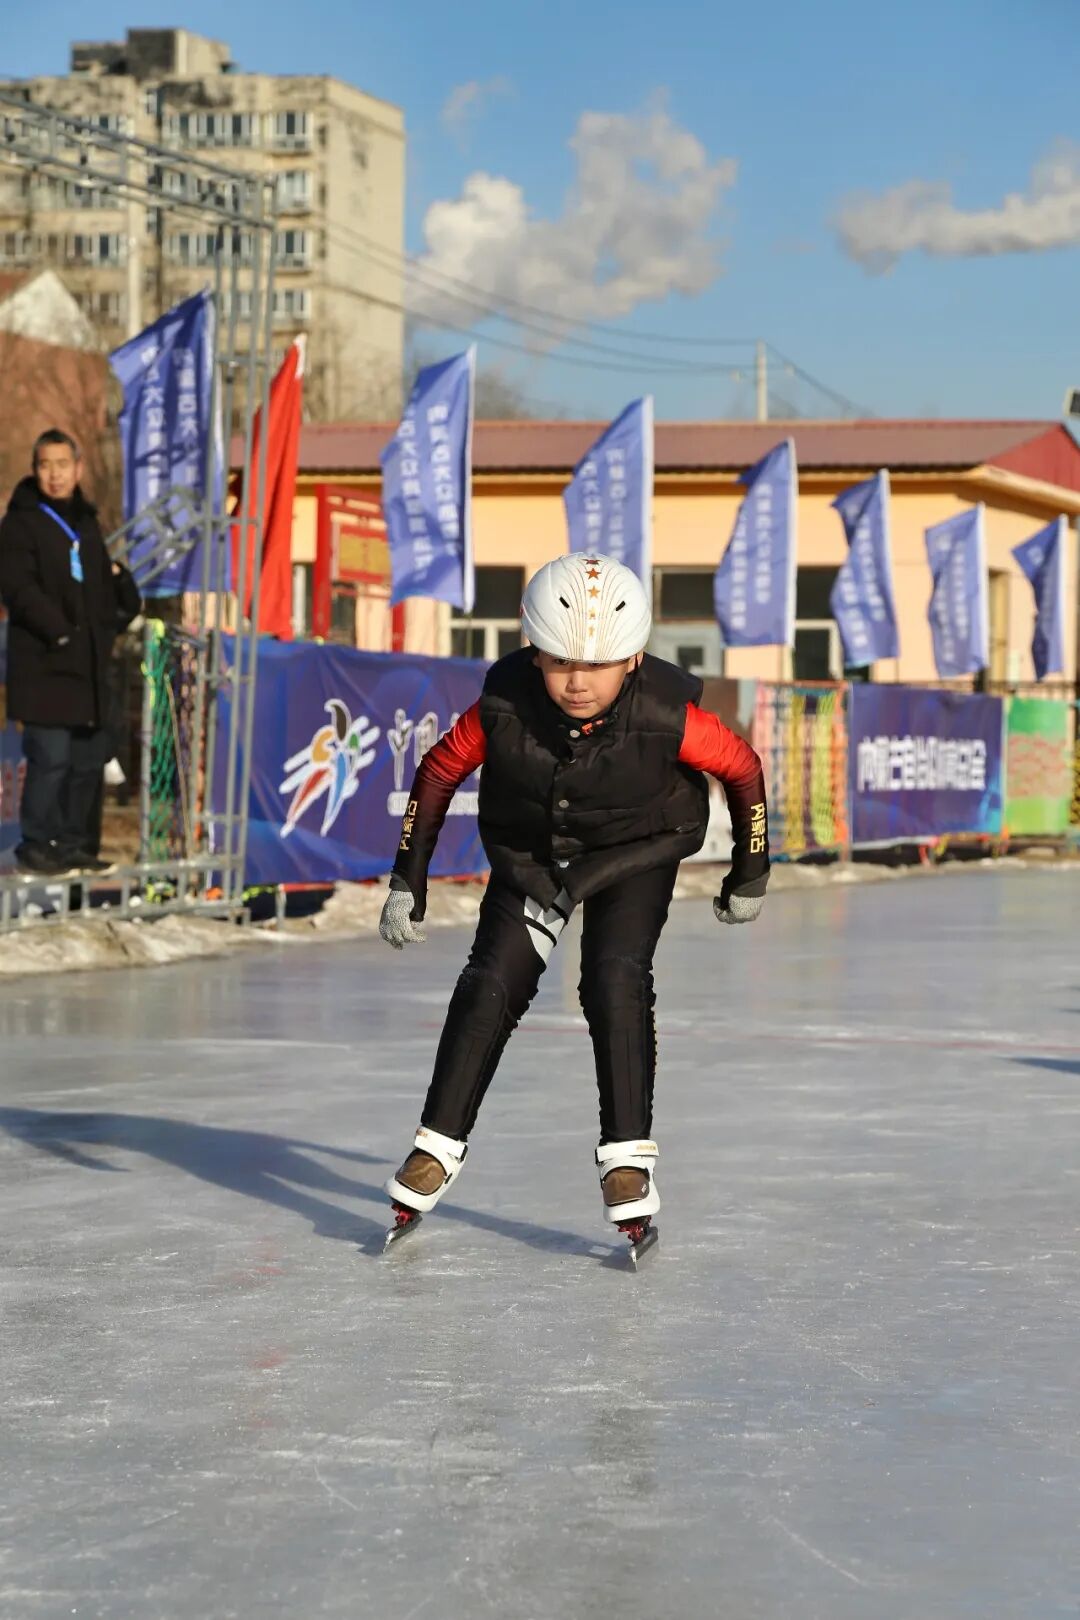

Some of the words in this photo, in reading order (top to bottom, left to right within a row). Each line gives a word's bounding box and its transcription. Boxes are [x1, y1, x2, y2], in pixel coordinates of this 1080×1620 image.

[400, 800, 418, 850] 内蒙古
[751, 803, 766, 853] 内蒙古
